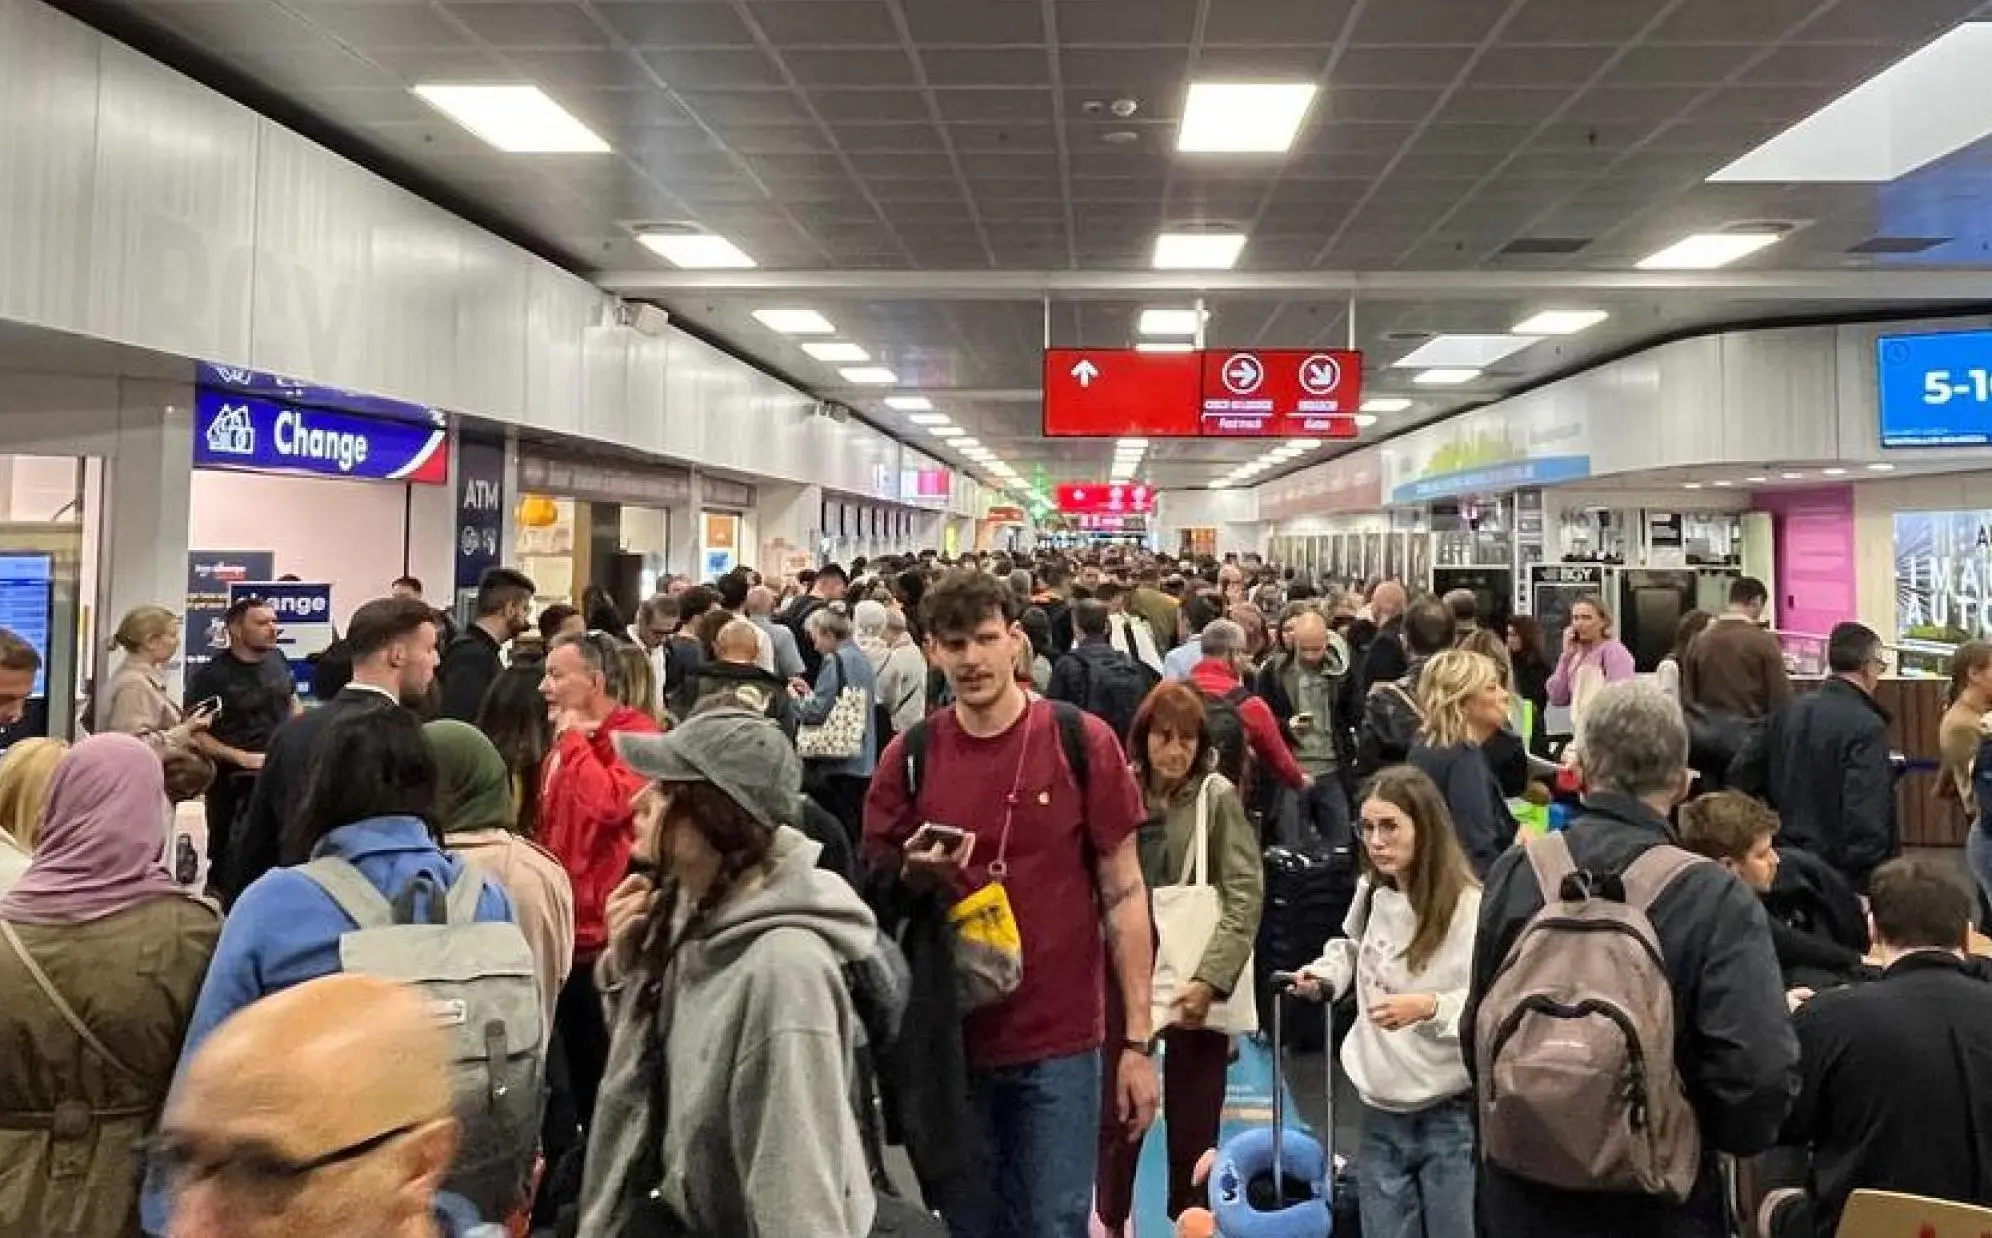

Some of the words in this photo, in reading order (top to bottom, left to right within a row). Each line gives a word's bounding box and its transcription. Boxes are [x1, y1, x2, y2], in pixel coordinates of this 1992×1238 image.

[1923, 369, 1992, 404] 5-1
[274, 409, 369, 471] Change
[463, 479, 498, 510] ATM
